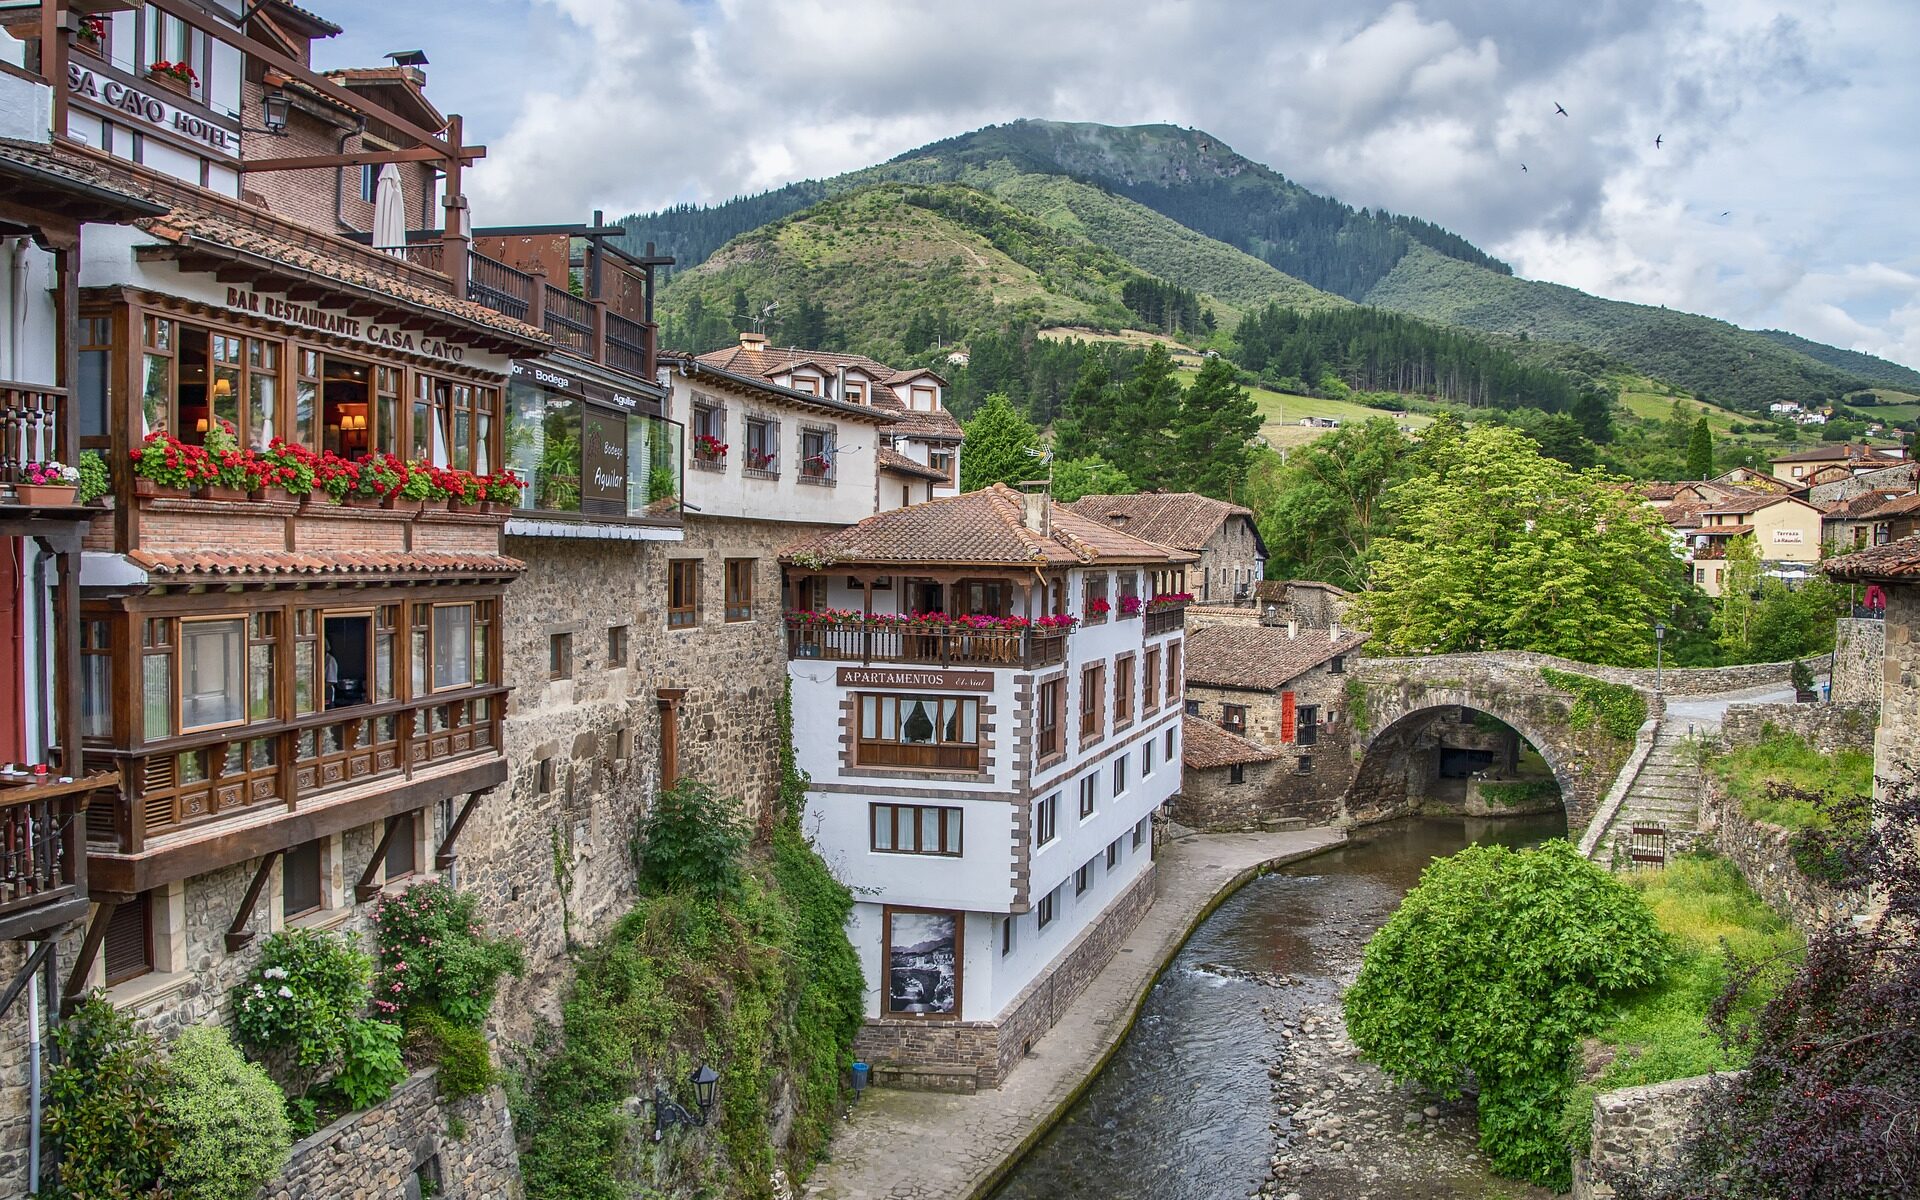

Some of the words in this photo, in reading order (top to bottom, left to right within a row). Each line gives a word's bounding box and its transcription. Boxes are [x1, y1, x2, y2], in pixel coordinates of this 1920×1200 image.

[103, 81, 166, 123] CAYO
[174, 111, 231, 150] HOTEL
[226, 286, 259, 313] BAR
[264, 296, 360, 337] RESTAURANTE
[366, 324, 415, 351] CASA
[421, 337, 464, 362] CAYO
[535, 369, 569, 388] Bodega
[613, 393, 637, 407] Aguilar
[594, 466, 623, 491] Aguilar
[844, 671, 944, 685] APARTAMENTOS
